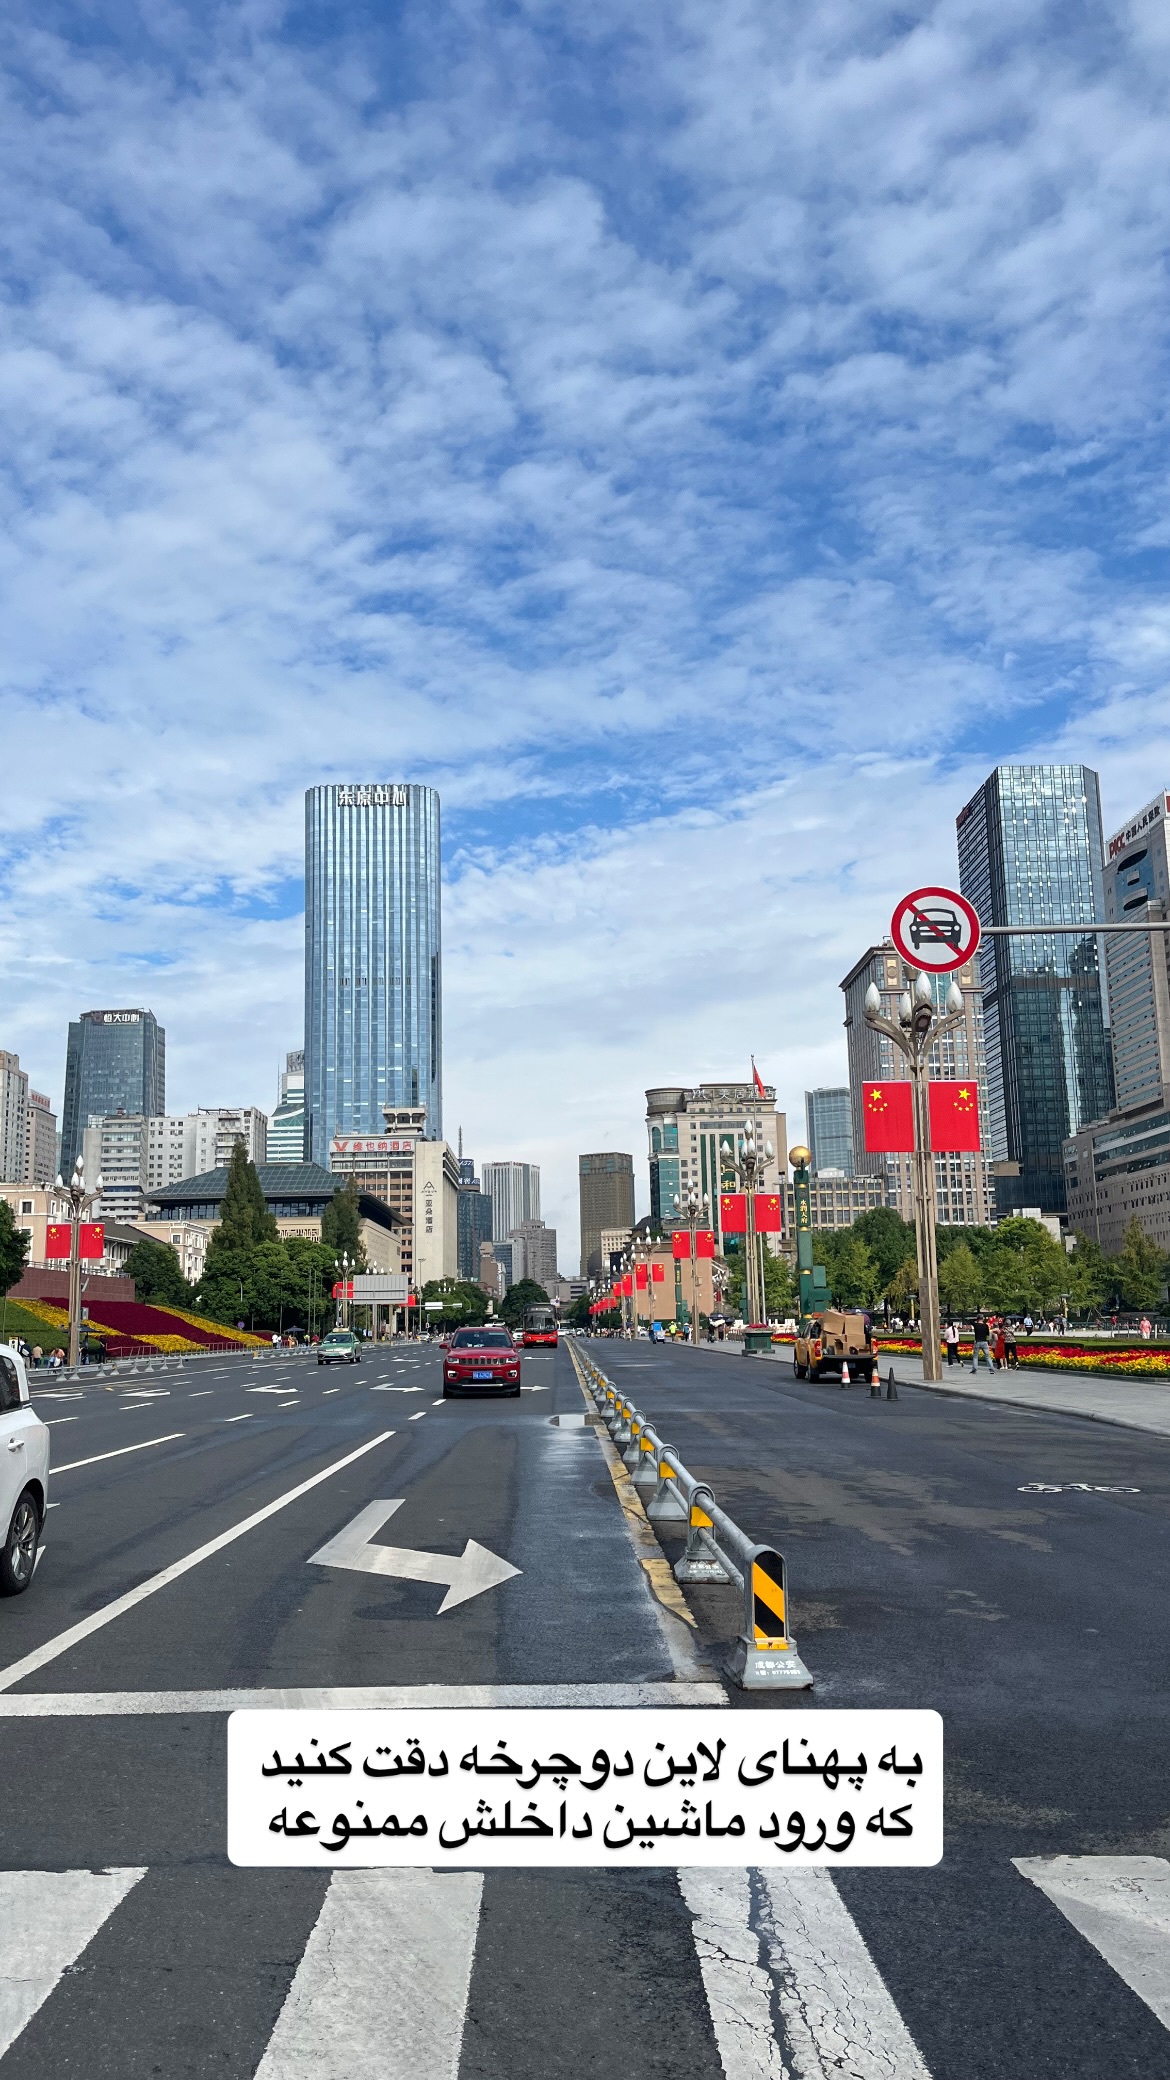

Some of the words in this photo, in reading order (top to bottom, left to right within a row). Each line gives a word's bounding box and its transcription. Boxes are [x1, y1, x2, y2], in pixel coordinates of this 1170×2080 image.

[338, 790, 407, 806] 东原中心
[1109, 832, 1126, 860] PICC
[353, 1141, 412, 1152] 维也纳酒店
